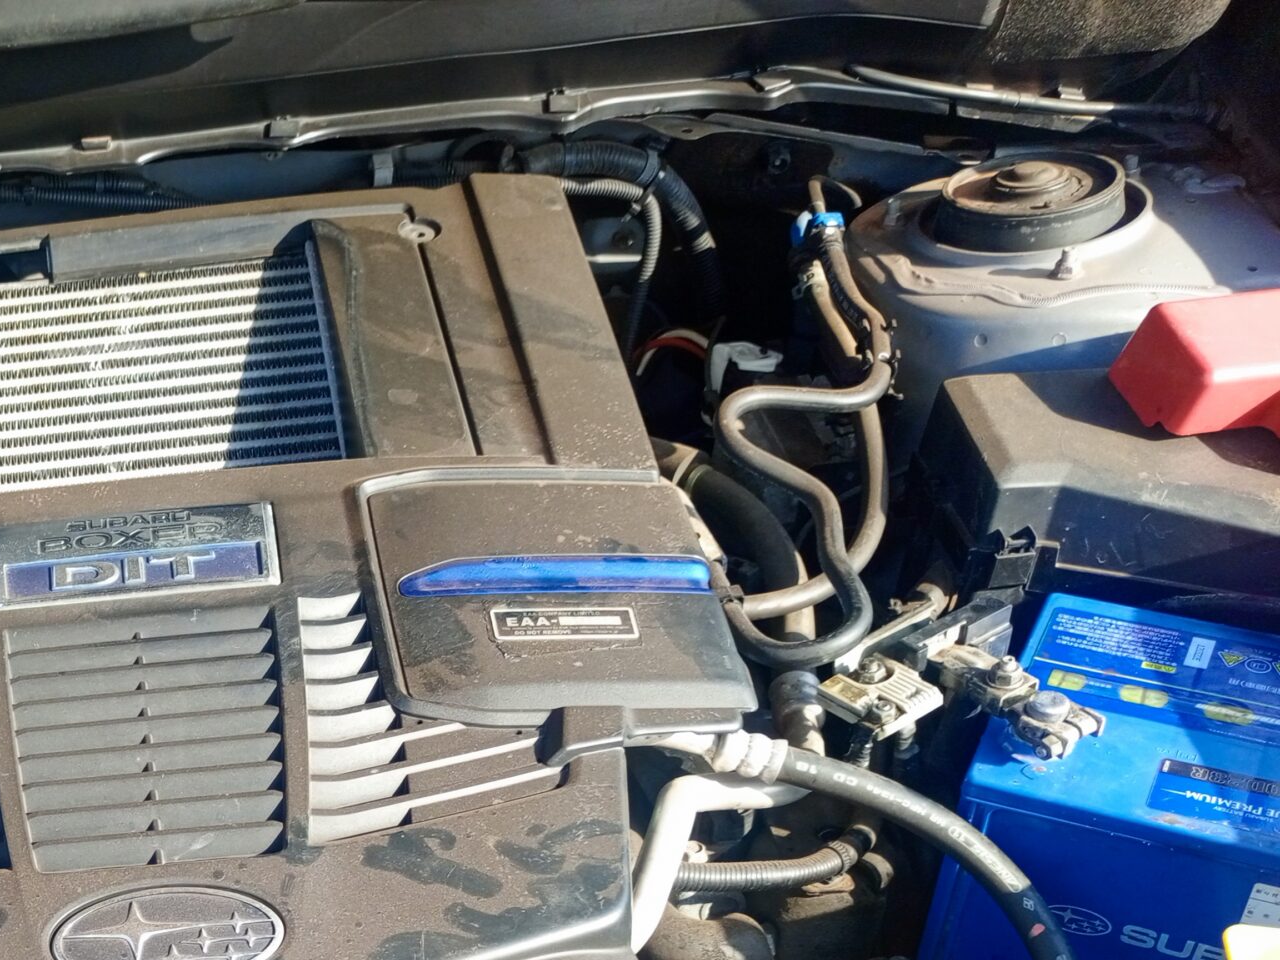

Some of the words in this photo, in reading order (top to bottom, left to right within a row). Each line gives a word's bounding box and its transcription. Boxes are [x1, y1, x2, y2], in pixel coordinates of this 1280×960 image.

[65, 509, 192, 533] SUBARU
[35, 520, 225, 555] BOXER
[49, 548, 217, 592] DIT
[1185, 789, 1264, 816] PREMIUM
